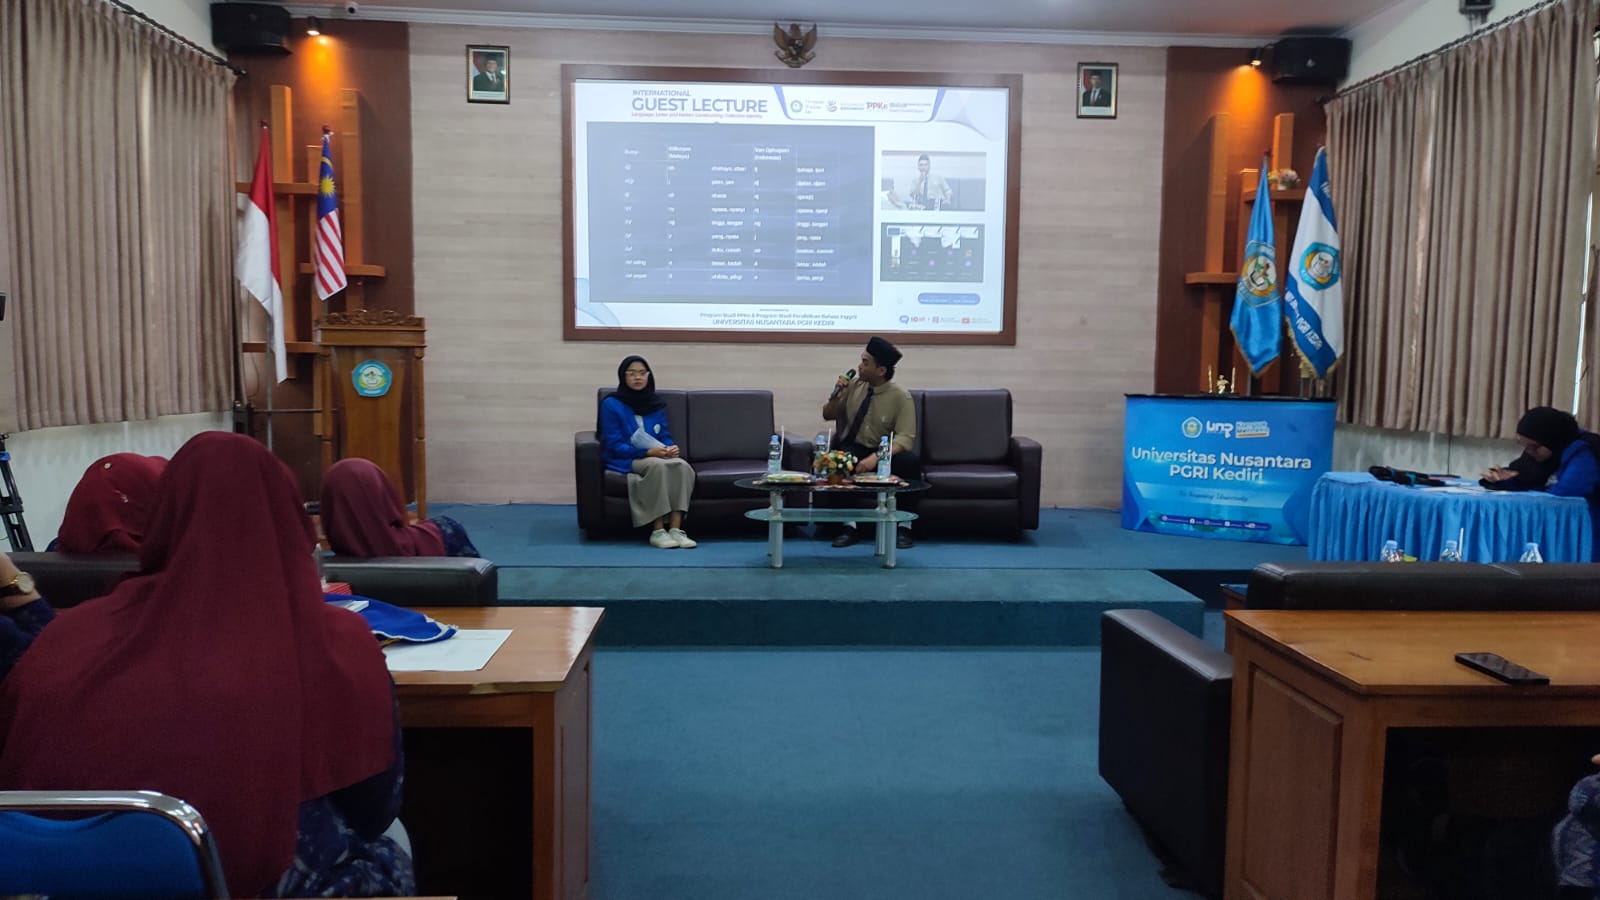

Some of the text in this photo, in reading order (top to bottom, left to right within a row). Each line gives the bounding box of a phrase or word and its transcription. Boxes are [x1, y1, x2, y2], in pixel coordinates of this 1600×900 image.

[632, 89, 692, 97] INTERNATIONAL
[631, 97, 768, 113] GUEST LECTURE
[1131, 446, 1312, 470] Universitas Nusantara
[1169, 464, 1264, 482] PGRI Kediri
